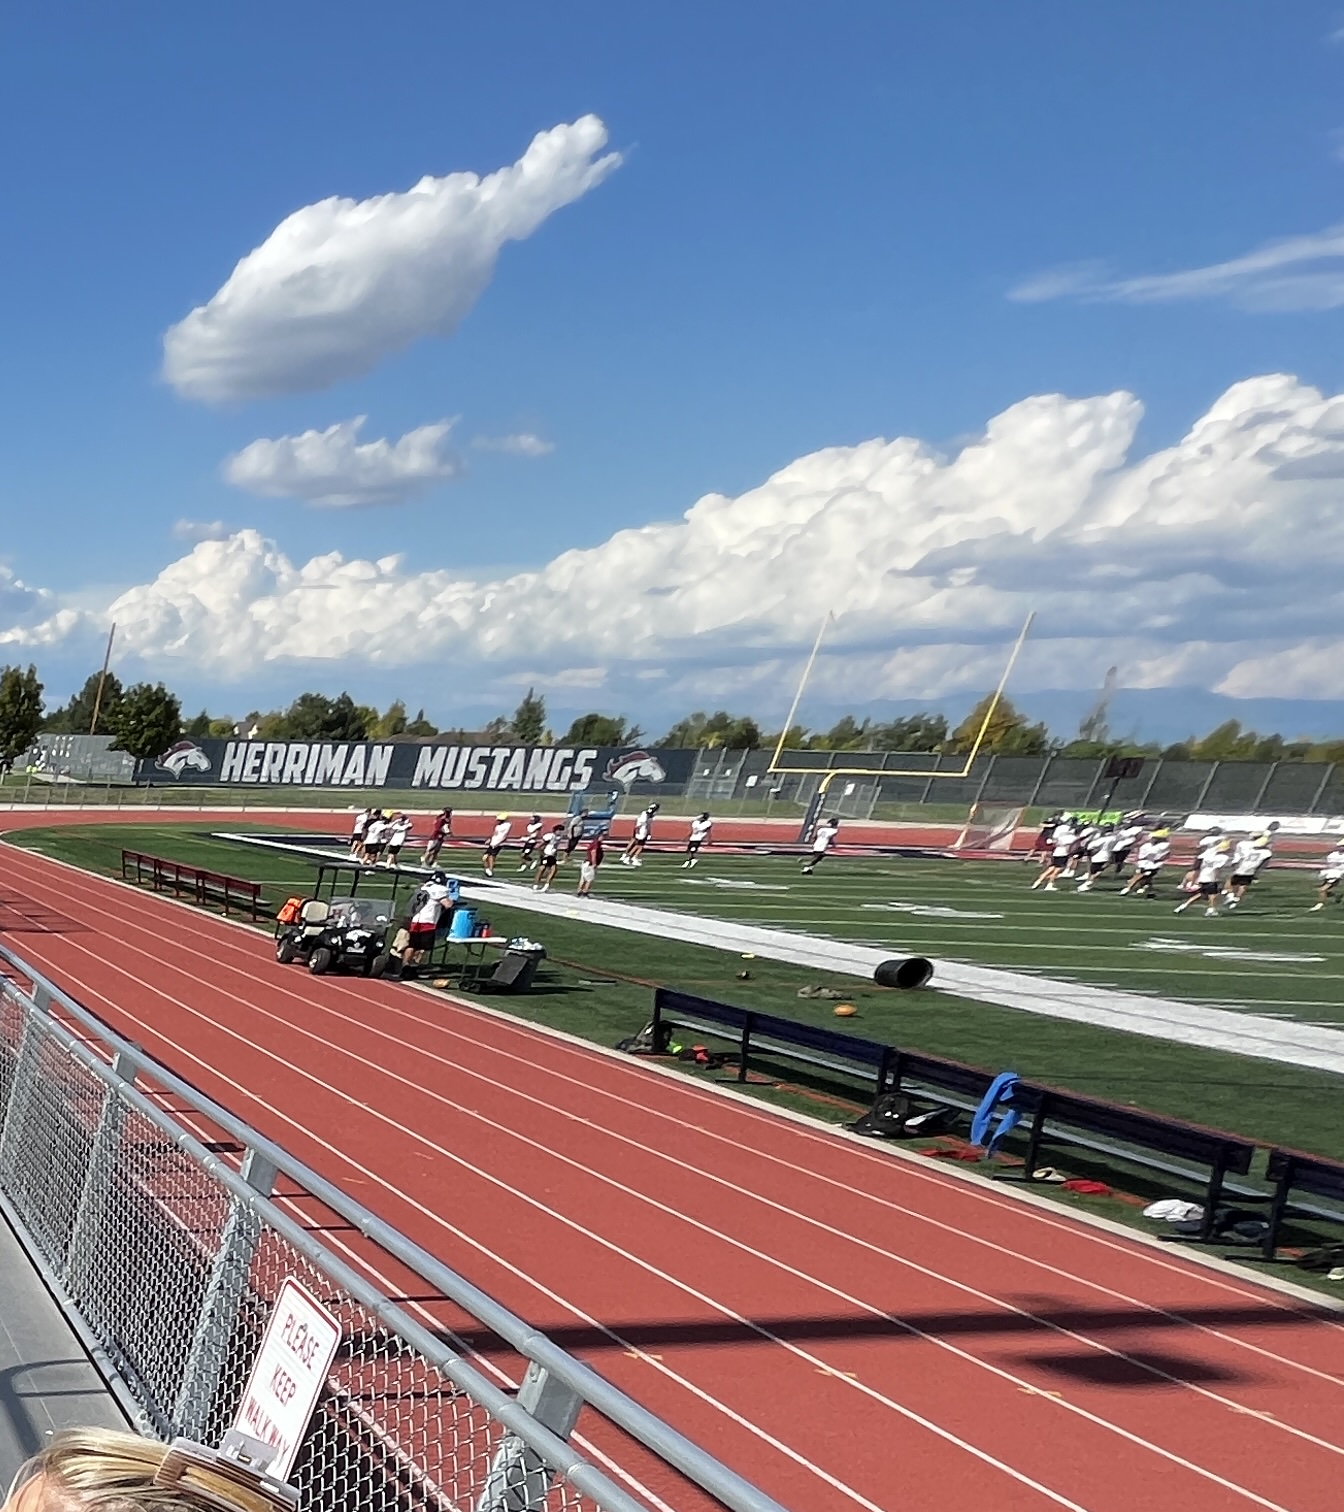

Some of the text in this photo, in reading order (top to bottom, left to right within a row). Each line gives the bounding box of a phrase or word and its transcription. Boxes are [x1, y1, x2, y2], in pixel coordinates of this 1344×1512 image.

[219, 741, 597, 791] HERRIMAN MUSTANGS
[281, 1313, 319, 1370] PLEASE
[269, 1363, 297, 1407] KEEP
